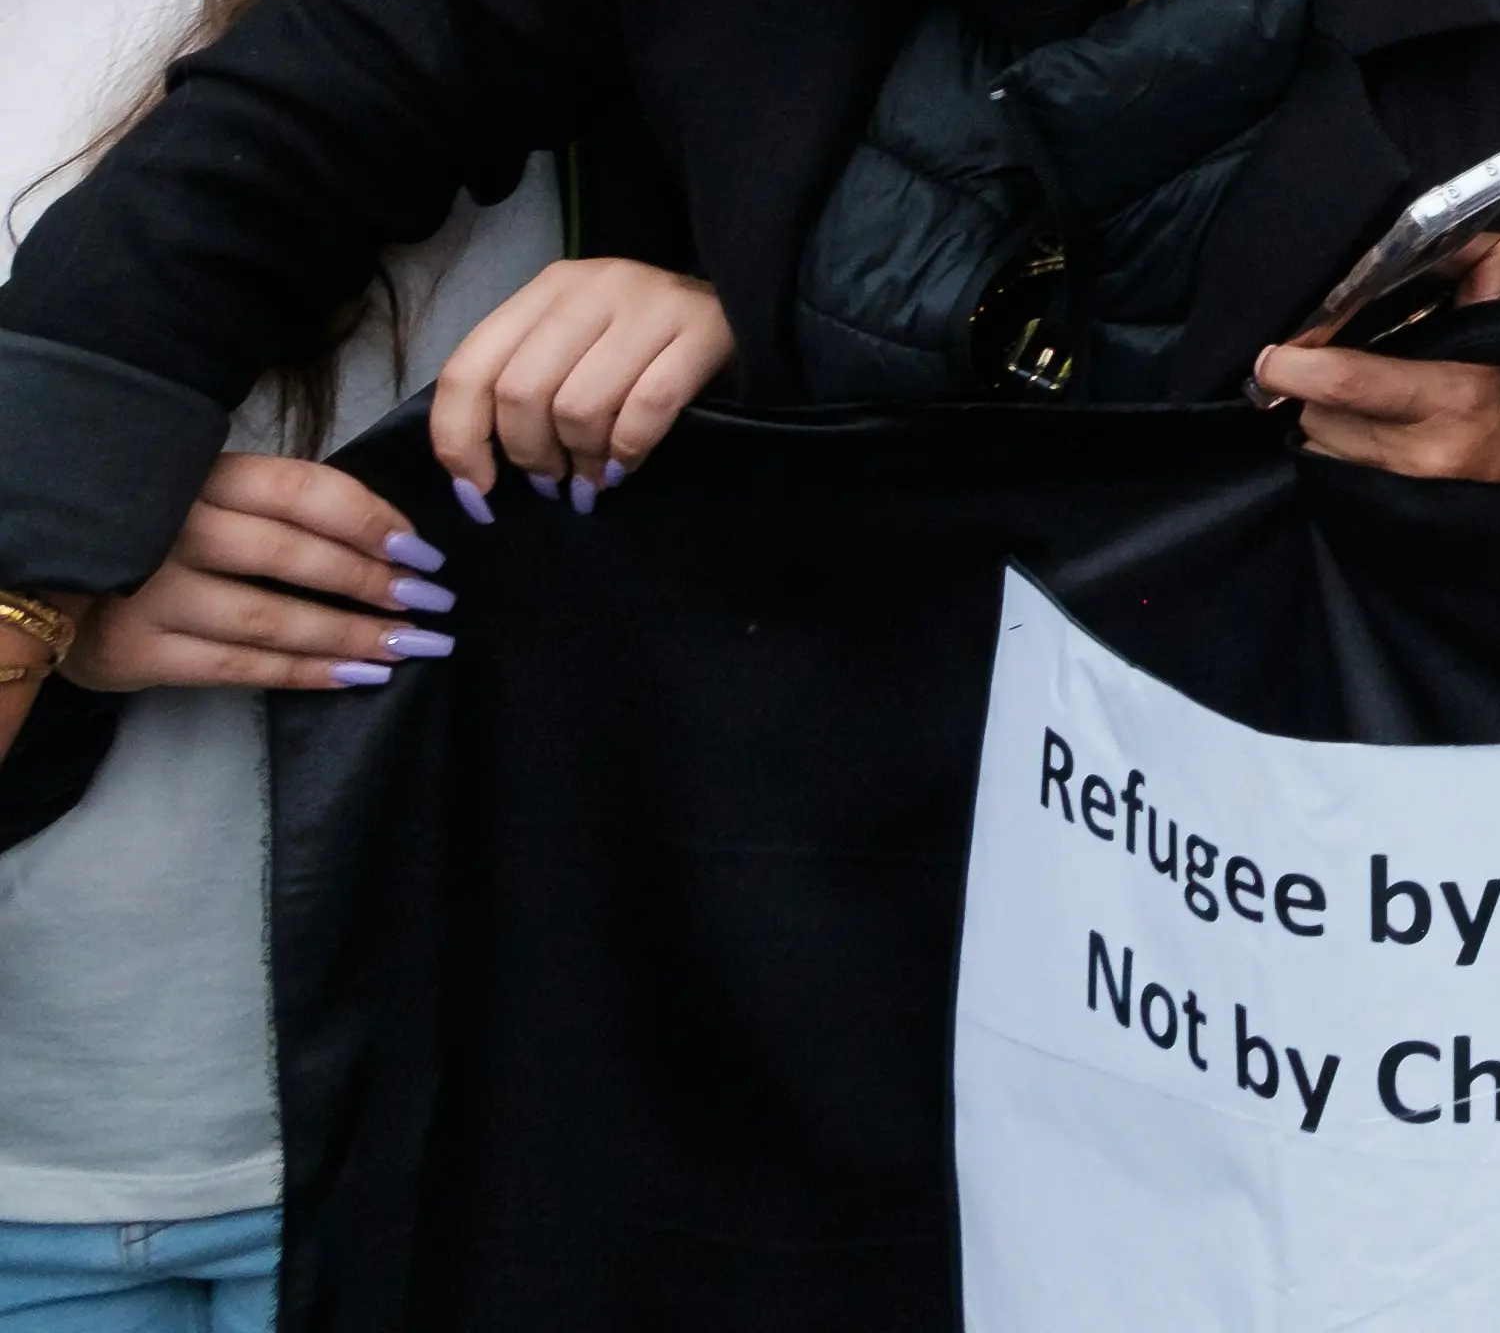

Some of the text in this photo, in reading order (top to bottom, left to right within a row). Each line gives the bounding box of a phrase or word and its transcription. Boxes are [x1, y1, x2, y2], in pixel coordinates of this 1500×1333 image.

[1039, 726, 1328, 936] Refugee
[1084, 930, 1208, 1073] Not
[1234, 1002, 1342, 1133] by
